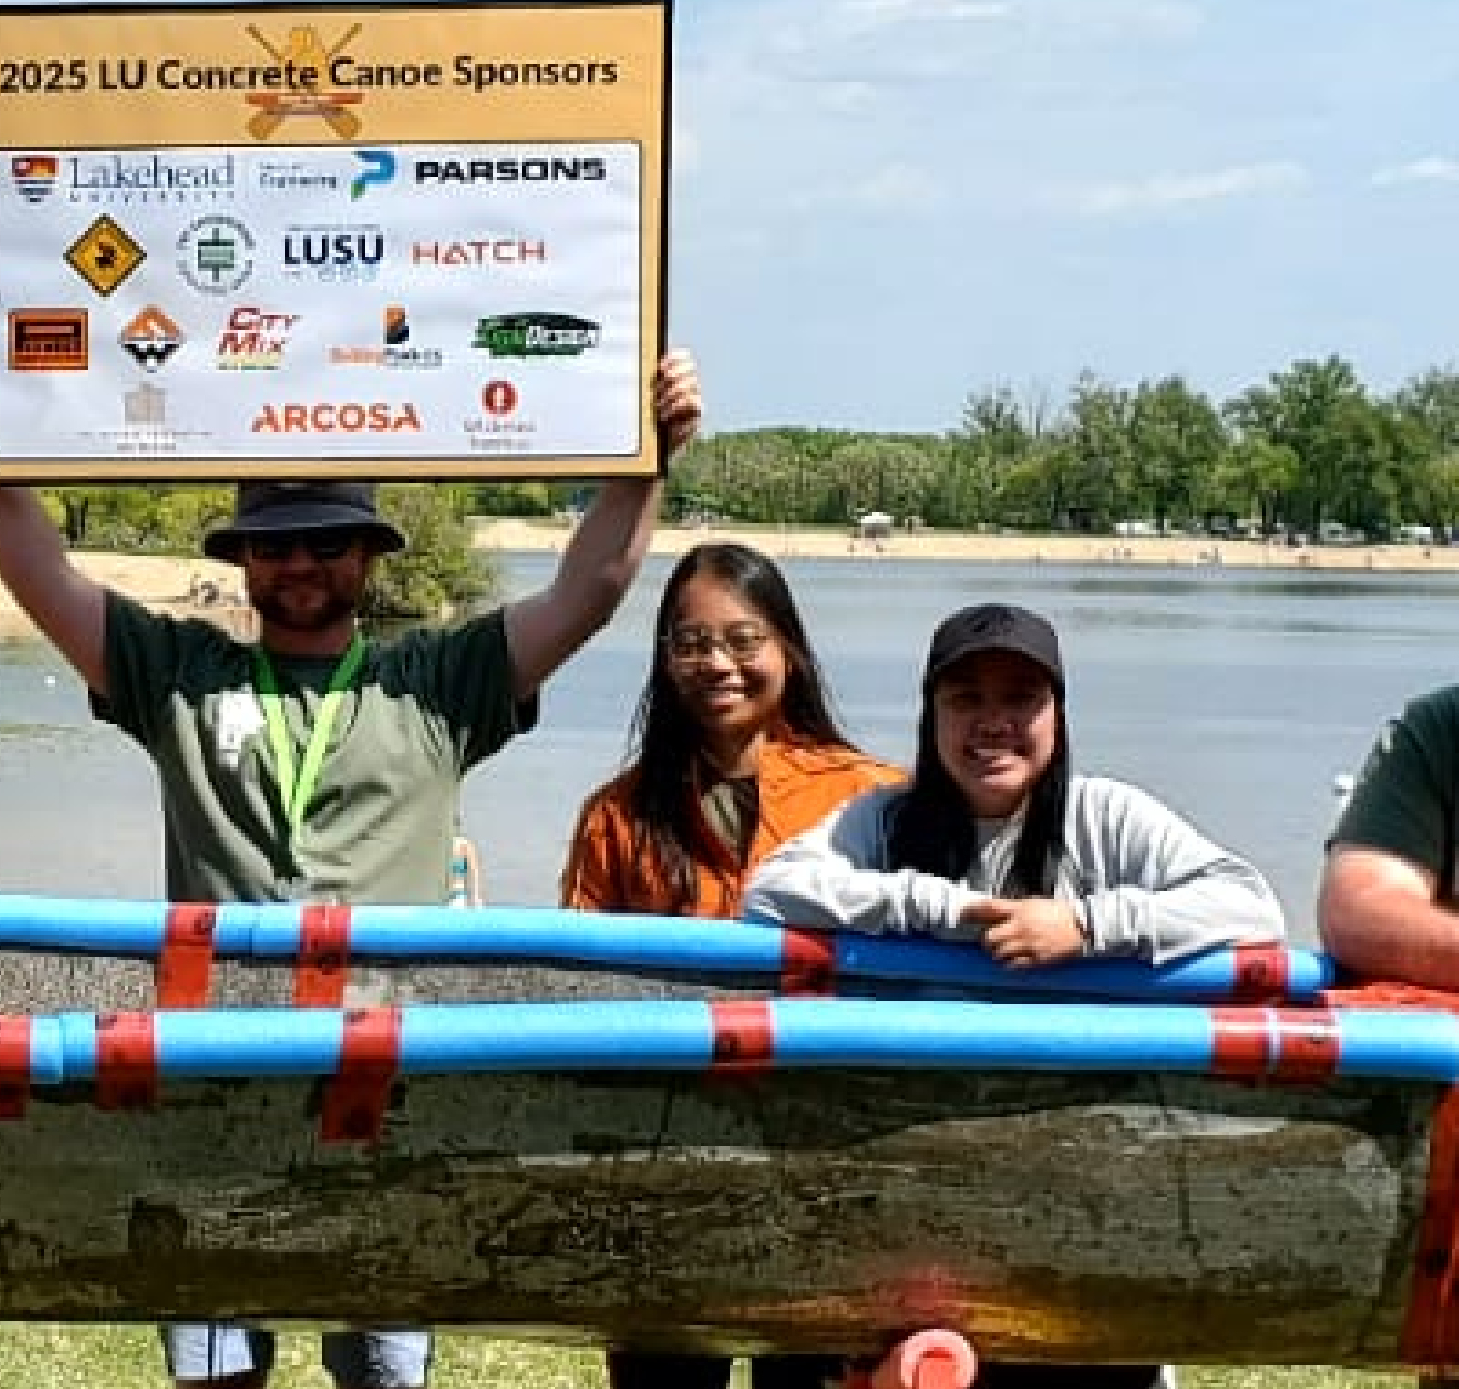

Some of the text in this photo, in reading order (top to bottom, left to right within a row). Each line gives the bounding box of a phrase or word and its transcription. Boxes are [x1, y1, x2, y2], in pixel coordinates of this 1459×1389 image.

[99, 59, 147, 90] LU
[157, 59, 319, 90] Concrete
[330, 56, 443, 86] Canoe
[452, 55, 618, 93] Sponsors
[69, 154, 234, 188] Lakehead
[415, 157, 607, 184] PARSONS
[284, 234, 384, 265] LUSU
[412, 239, 545, 265] HATCH
[251, 403, 422, 433] ARCOSA
